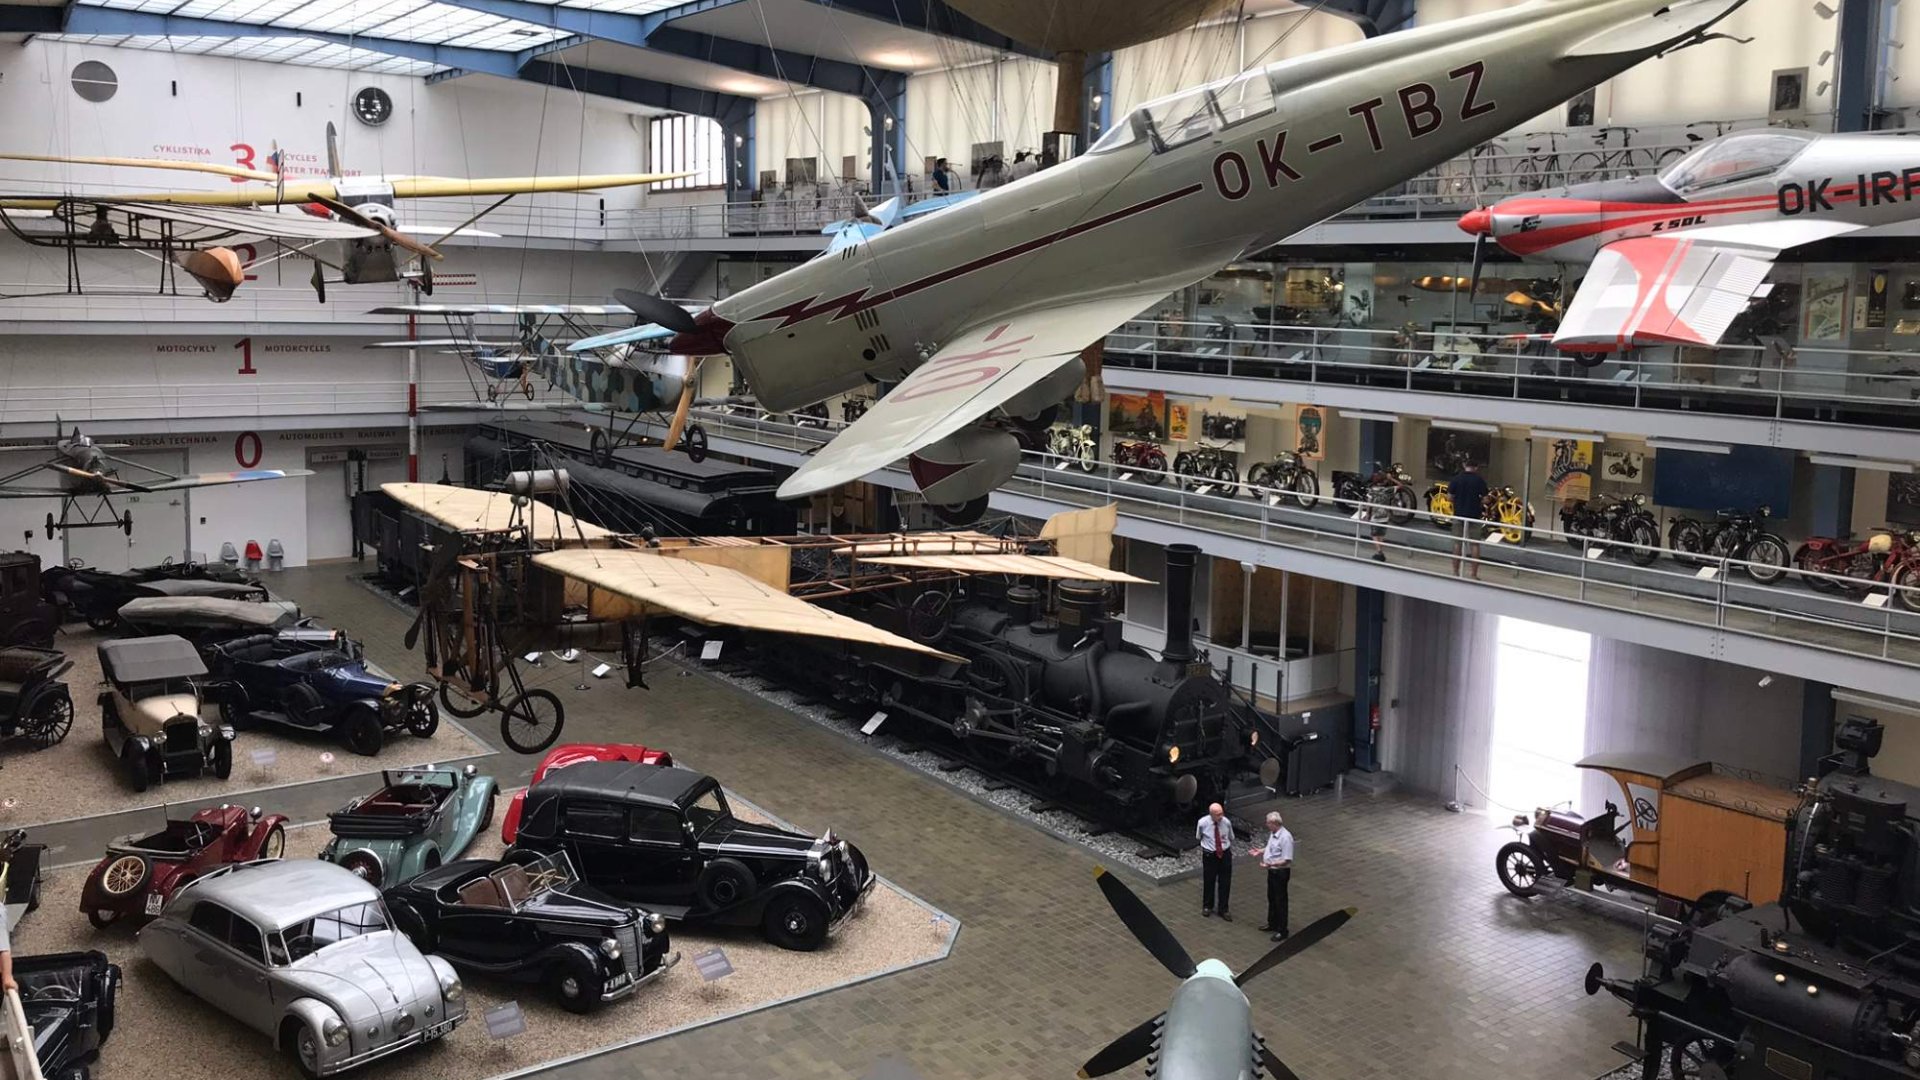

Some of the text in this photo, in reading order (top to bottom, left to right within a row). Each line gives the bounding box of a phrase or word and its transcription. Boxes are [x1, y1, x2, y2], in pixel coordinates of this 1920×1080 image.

[1212, 59, 1497, 201] OK-TBZ
[153, 144, 211, 156] CYKLISTIKA
[230, 143, 256, 183] 3
[284, 153, 318, 162] CYCLES
[283, 166, 306, 174] ATER
[232, 243, 258, 281] 2
[157, 344, 217, 353] MOTOCYKLY
[264, 344, 331, 353] MOTORCYCLES
[234, 337, 257, 375] 1
[169, 436, 217, 445] TECHNIKA
[279, 432, 344, 441] AUTOMOBILES
[358, 430, 396, 439] RAILWAY
[234, 430, 263, 469] 0
